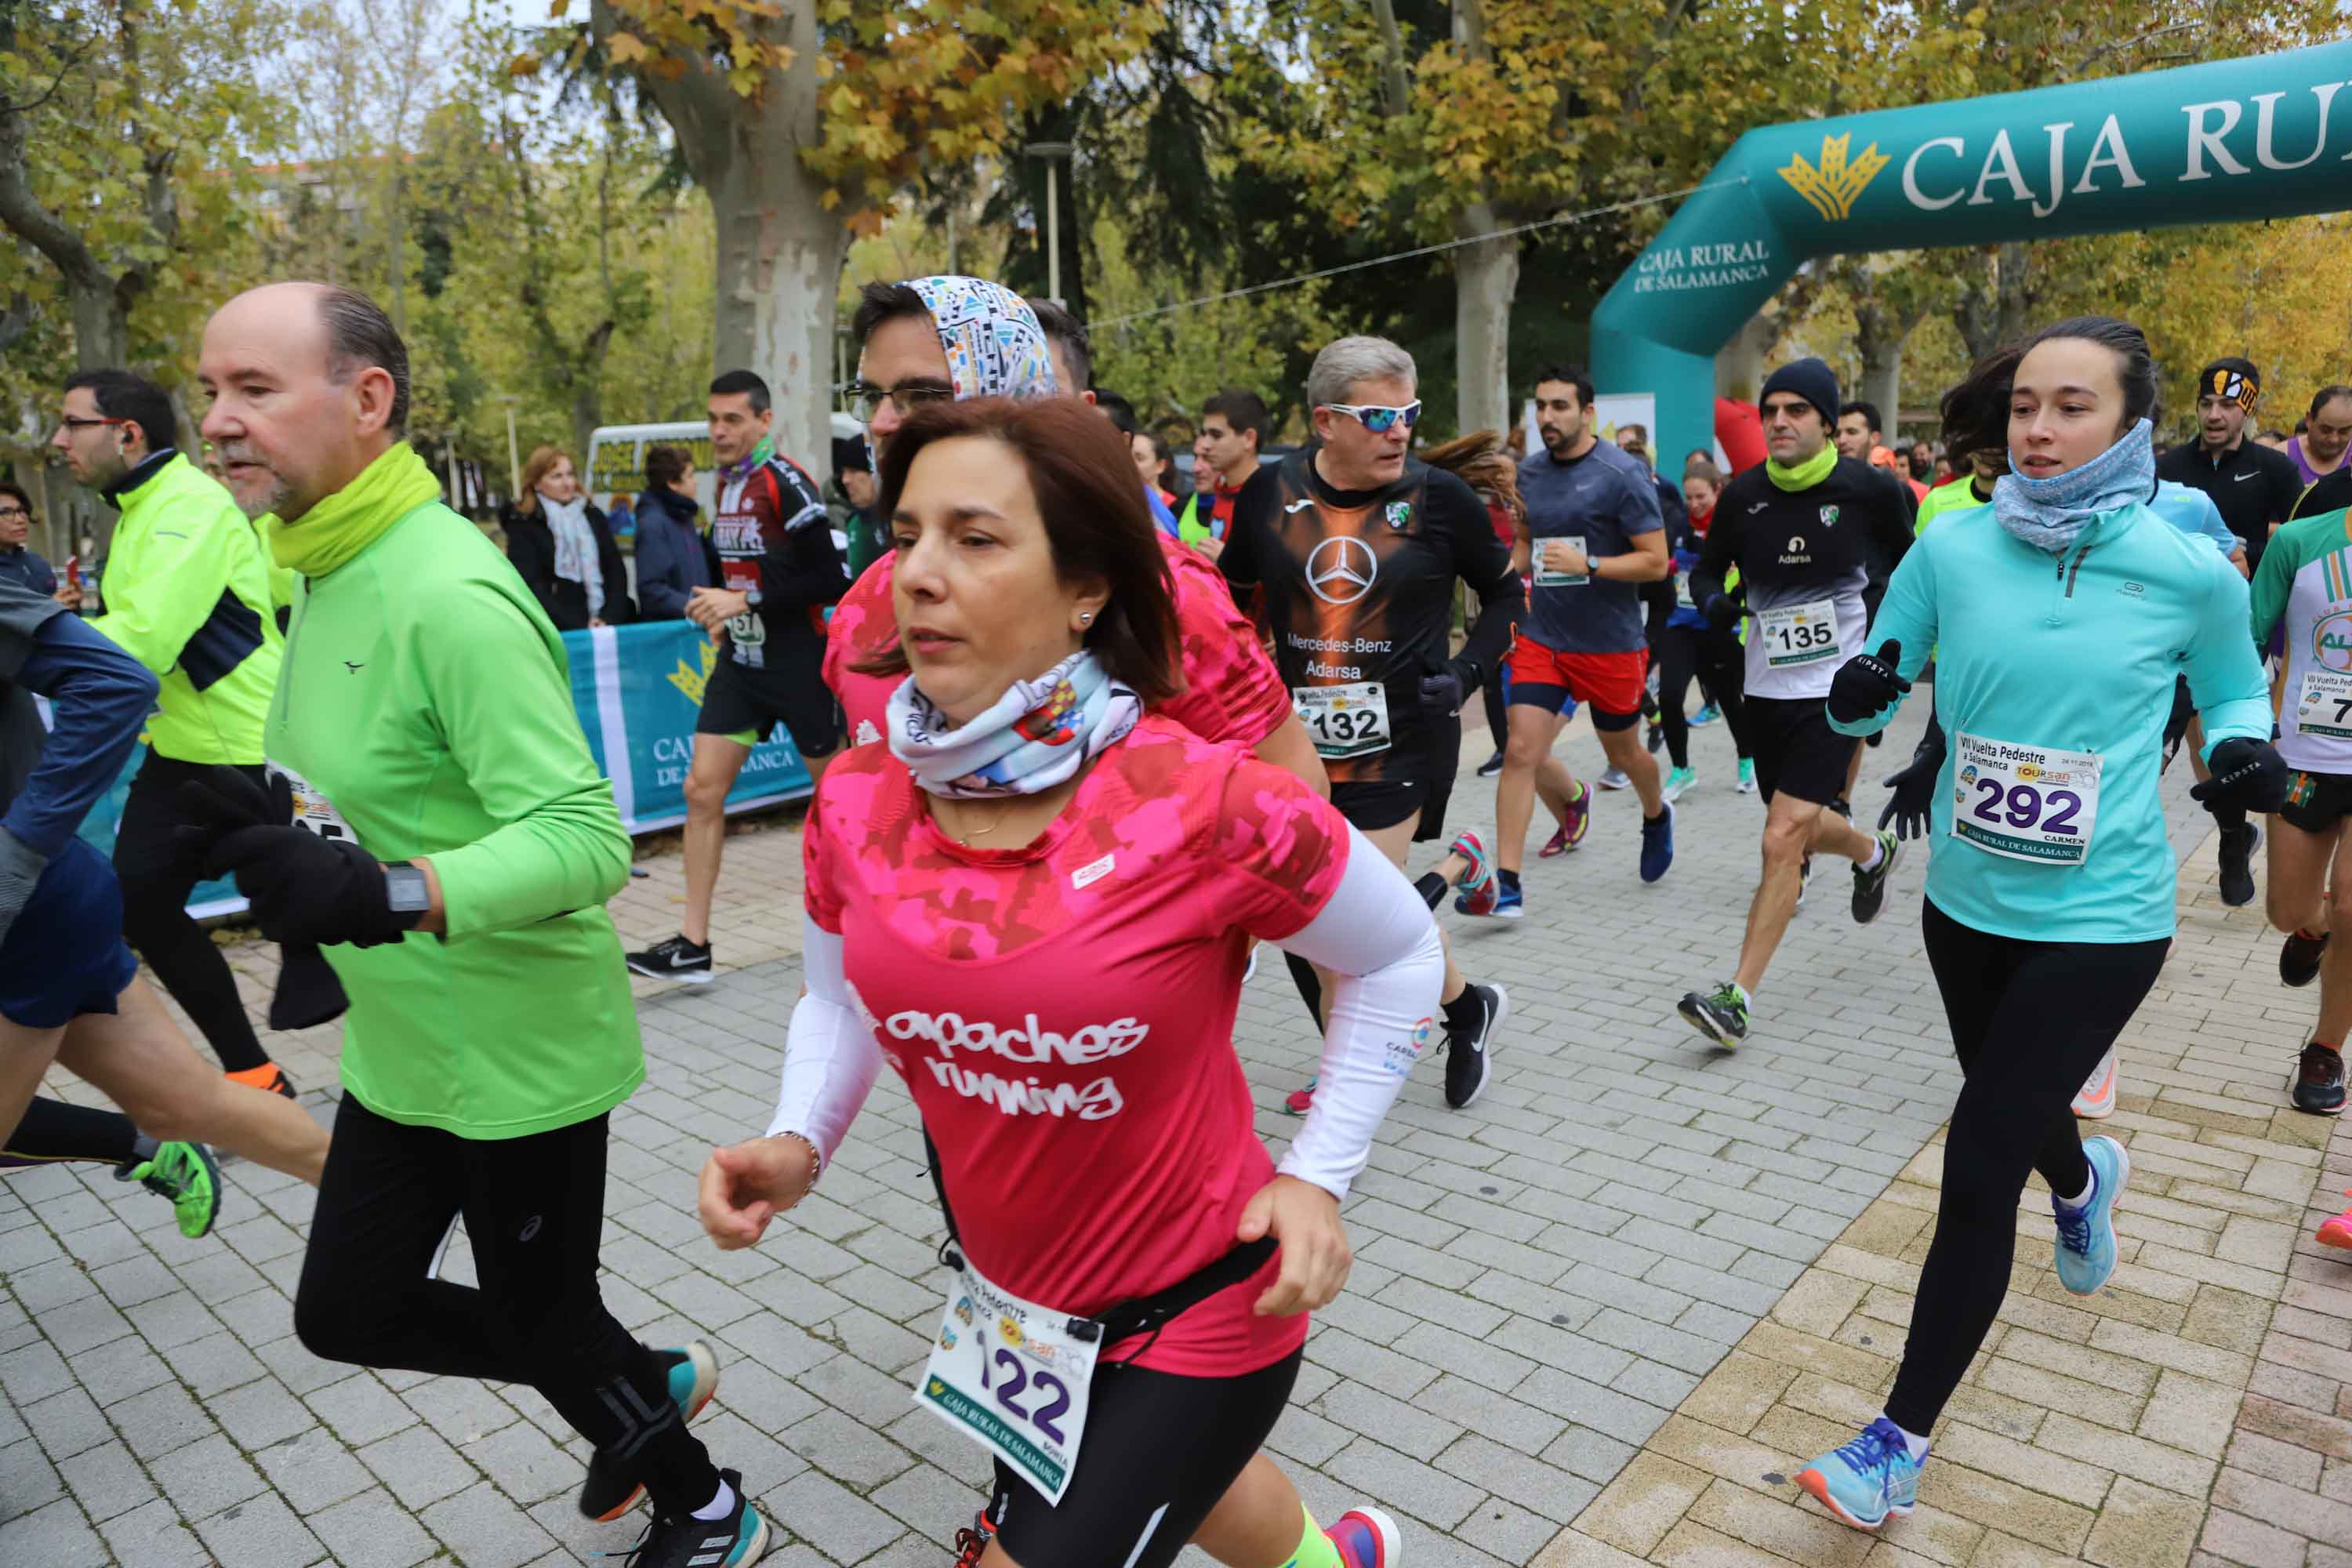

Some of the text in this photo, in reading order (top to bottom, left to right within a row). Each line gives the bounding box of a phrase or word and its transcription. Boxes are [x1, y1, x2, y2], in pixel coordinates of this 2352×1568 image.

[1901, 81, 2352, 218] CAJA RU
[1639, 240, 1770, 275] CAJA RURAL
[1634, 264, 1769, 294] DE SALAMANCA
[1778, 554, 1812, 564] Adarsa
[1287, 633, 1392, 653] Mercedes-Benz
[1779, 622, 1832, 651] 135
[1306, 660, 1361, 680] Adarsa
[1857, 657, 1889, 678] KIPSTA
[2318, 677, 2339, 685] Vuelta
[1313, 710, 1381, 740] 132
[1961, 736, 2045, 764] VII Vuelta Pedestre
[1969, 752, 2008, 771] Salamanca
[657, 765, 683, 786] DE
[1974, 778, 2082, 835] 292
[2009, 841, 2021, 851] DE
[2022, 844, 2080, 859] SALAMANCA
[2045, 835, 2086, 844] CARMEN
[886, 1011, 1149, 1065] apaches
[924, 1056, 1123, 1120] running
[943, 1391, 968, 1420] CAJA
[1009, 1436, 1061, 1490] SALAMANCA
